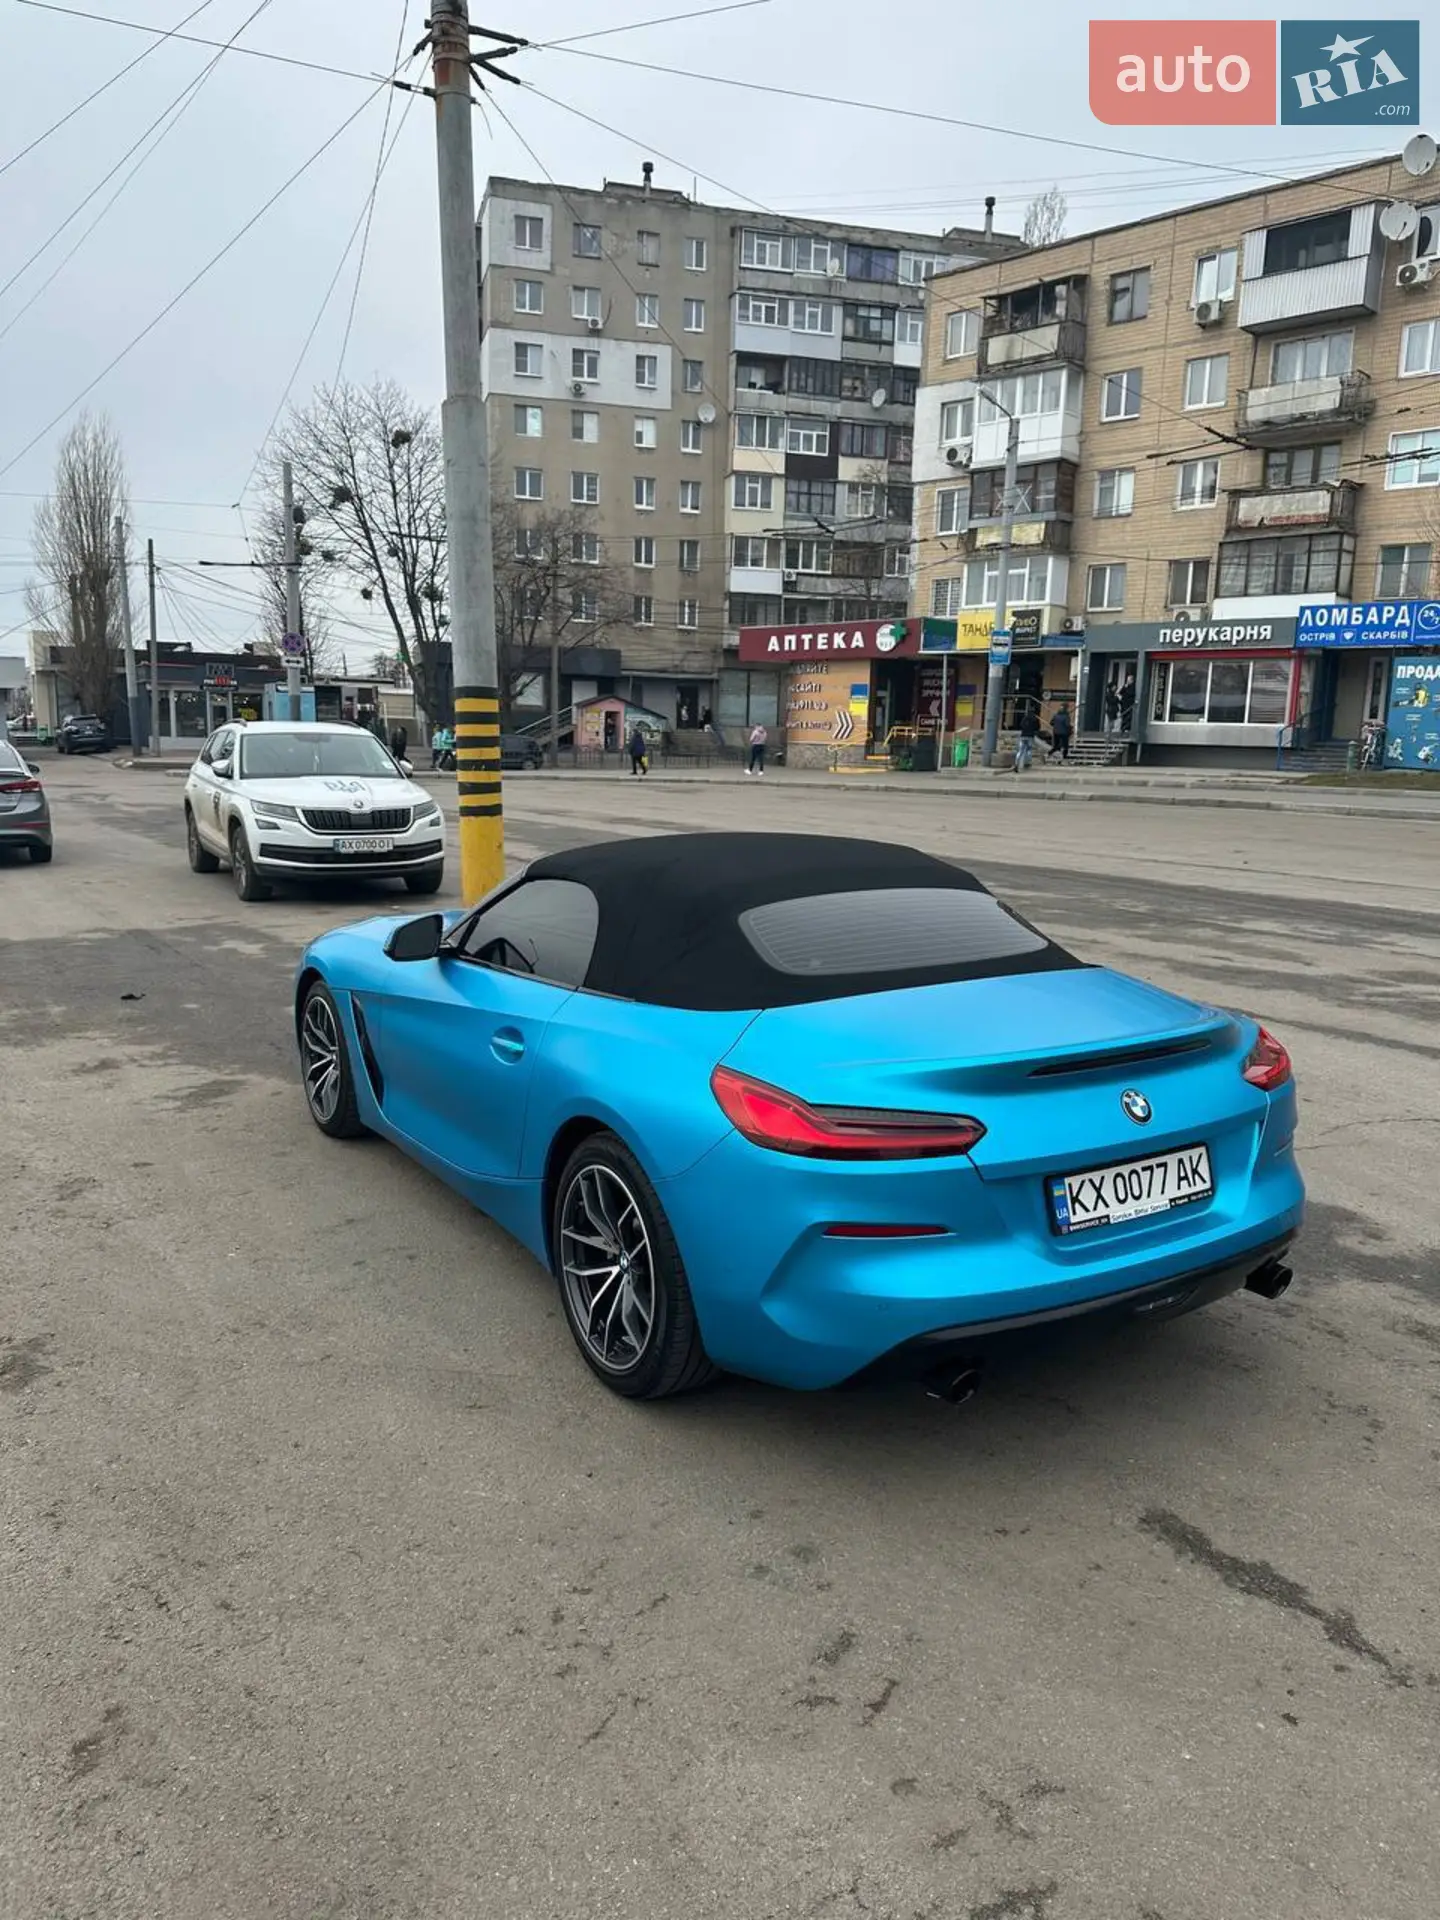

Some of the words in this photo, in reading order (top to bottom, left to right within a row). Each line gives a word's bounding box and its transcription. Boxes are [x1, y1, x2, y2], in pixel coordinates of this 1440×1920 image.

[1300, 604, 1411, 628] ЛОМБАРД
[767, 630, 865, 652] АПТЕКА
[1159, 623, 1272, 646] перукарня
[1299, 632, 1336, 641] ОСТРІВ
[1361, 630, 1408, 640] СКАРБІВ
[355, 840, 377, 850] 0700
[1068, 1175, 1110, 1216] KX
[1112, 1161, 1168, 1205] 0077
[1176, 1152, 1207, 1190] AK
[1056, 1208, 1068, 1219] UA
